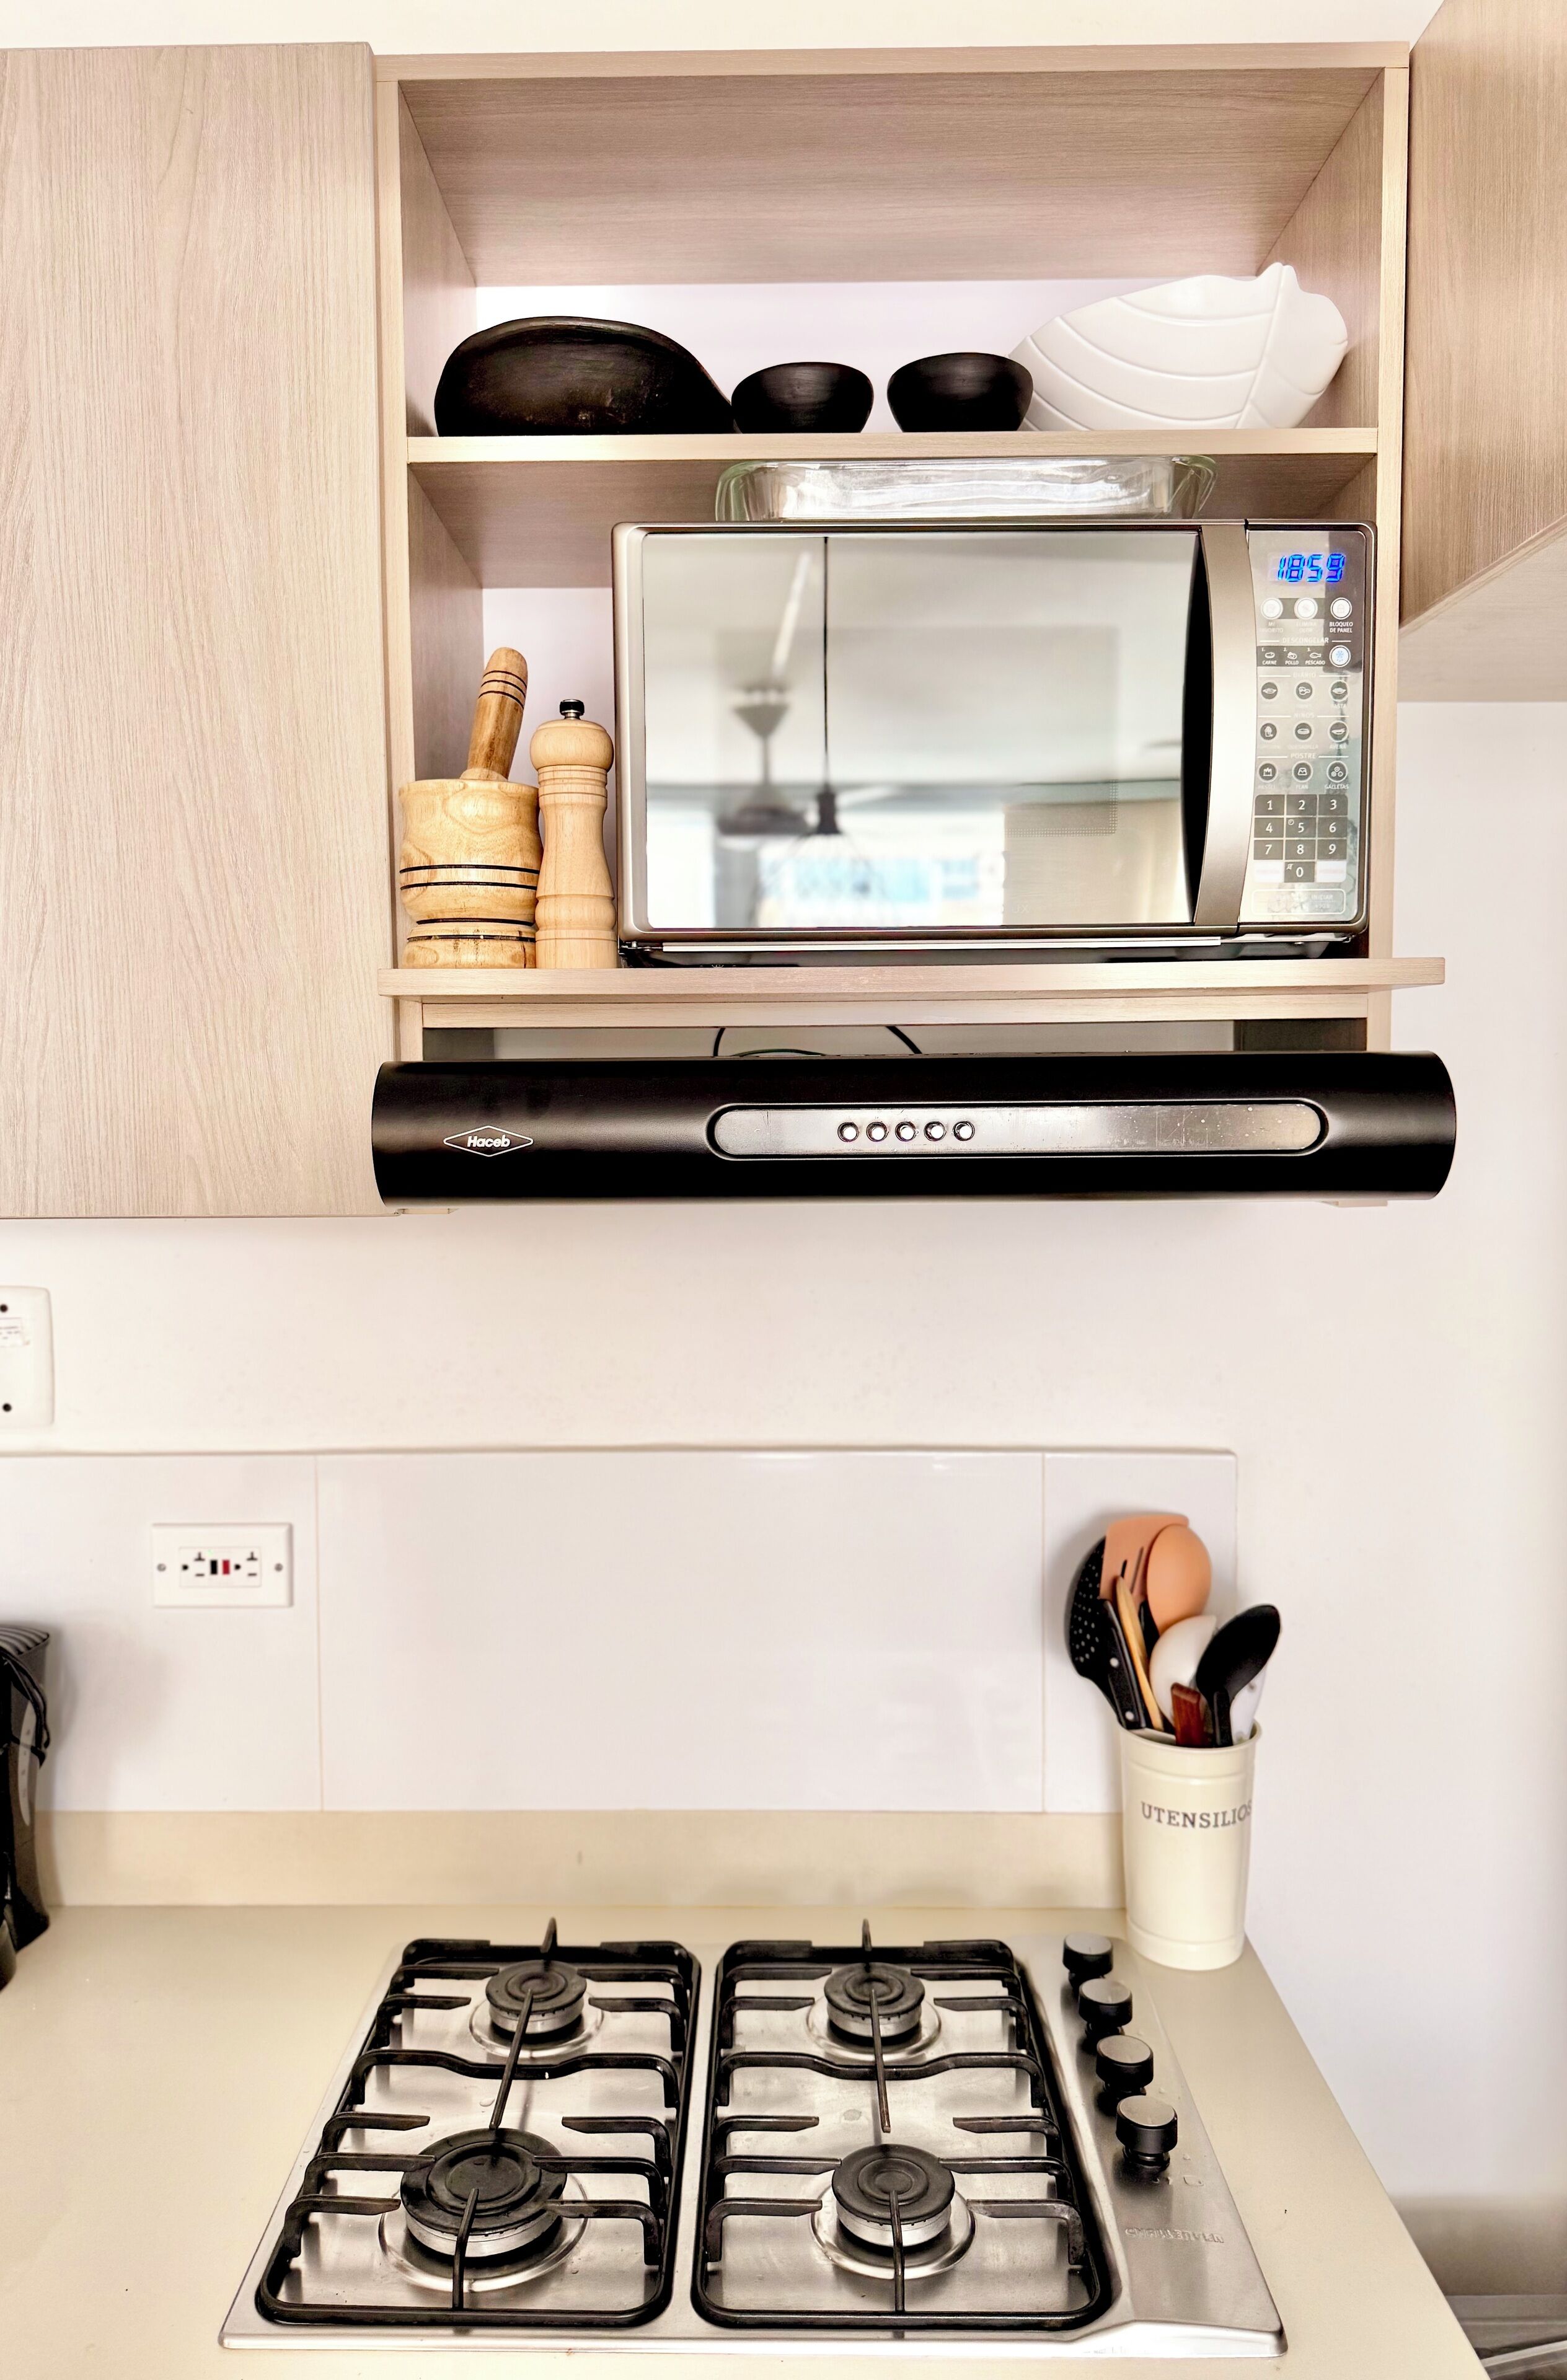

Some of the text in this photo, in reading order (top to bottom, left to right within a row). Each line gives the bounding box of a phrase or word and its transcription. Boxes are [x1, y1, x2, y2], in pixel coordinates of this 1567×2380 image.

[1278, 553, 1345, 582] 1859
[1267, 800, 1337, 810] 1 2 3
[1266, 822, 1336, 833] 4 5 6
[1265, 844, 1336, 855] 7 8 9
[1296, 866, 1304, 878] 0
[467, 1135, 511, 1147] Haceb
[1141, 1799, 1252, 1828] UTENSILIOS
